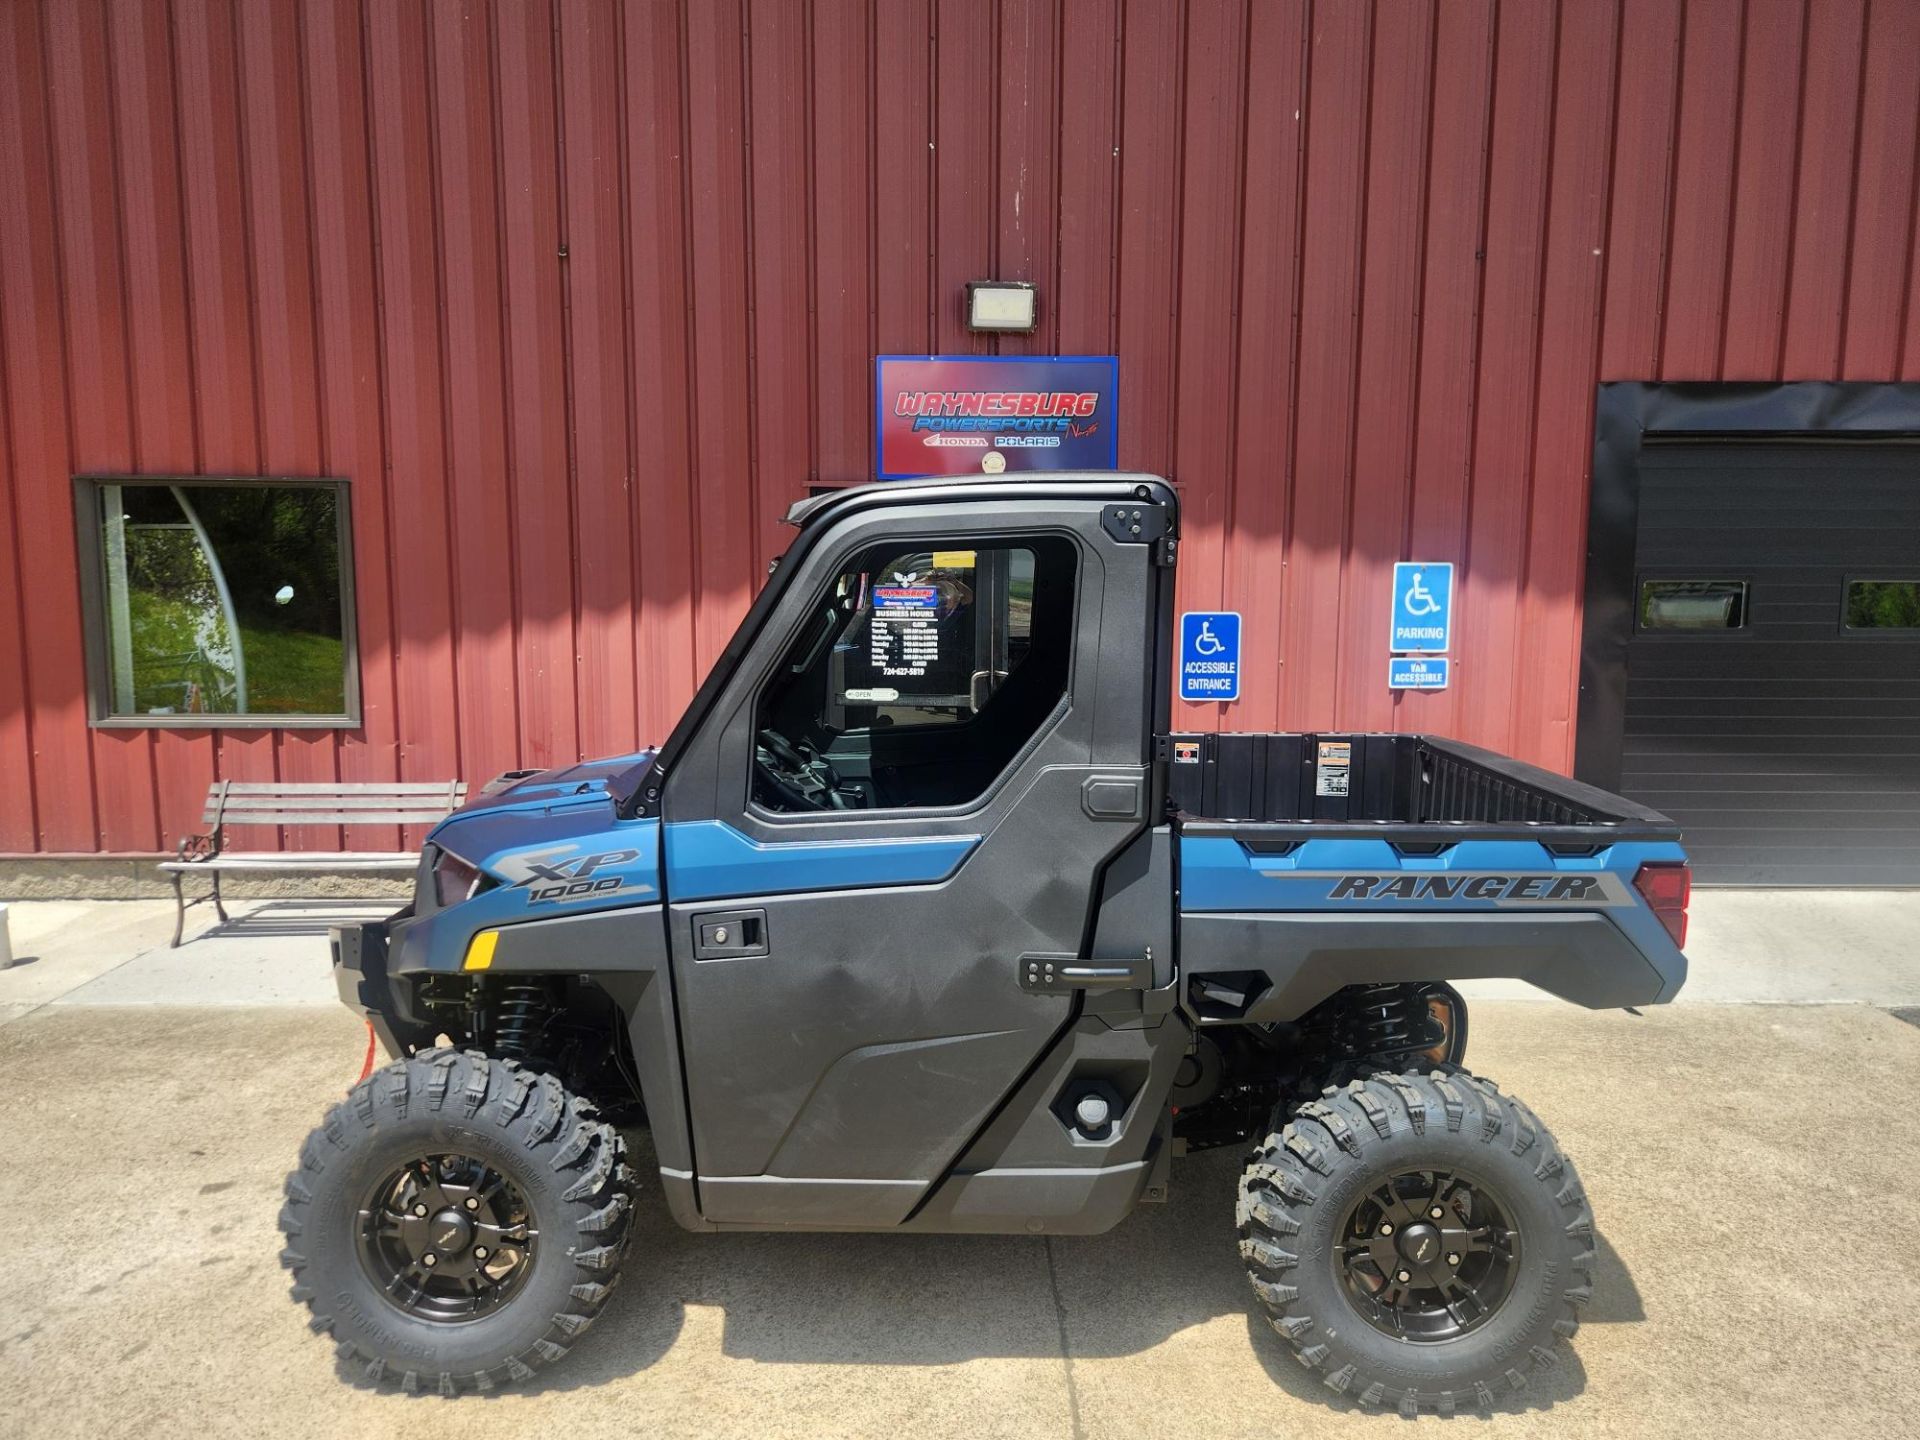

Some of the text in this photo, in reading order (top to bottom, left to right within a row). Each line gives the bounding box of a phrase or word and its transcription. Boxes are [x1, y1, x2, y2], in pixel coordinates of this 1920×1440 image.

[894, 391, 1099, 418] WAYNESBURG
[913, 417, 1070, 432] POWERSPORTS
[940, 436, 1060, 447] HONDA POLARIS
[1396, 627, 1444, 639] PARKING
[1185, 662, 1236, 673] ACCESSIBLE
[1410, 663, 1427, 673] VAN
[1394, 673, 1443, 682] ACCESSIBLE
[1188, 678, 1232, 690] ENTRANCE
[510, 849, 641, 888] XP
[529, 877, 623, 902] 1000
[1327, 875, 1600, 900] RANGER
